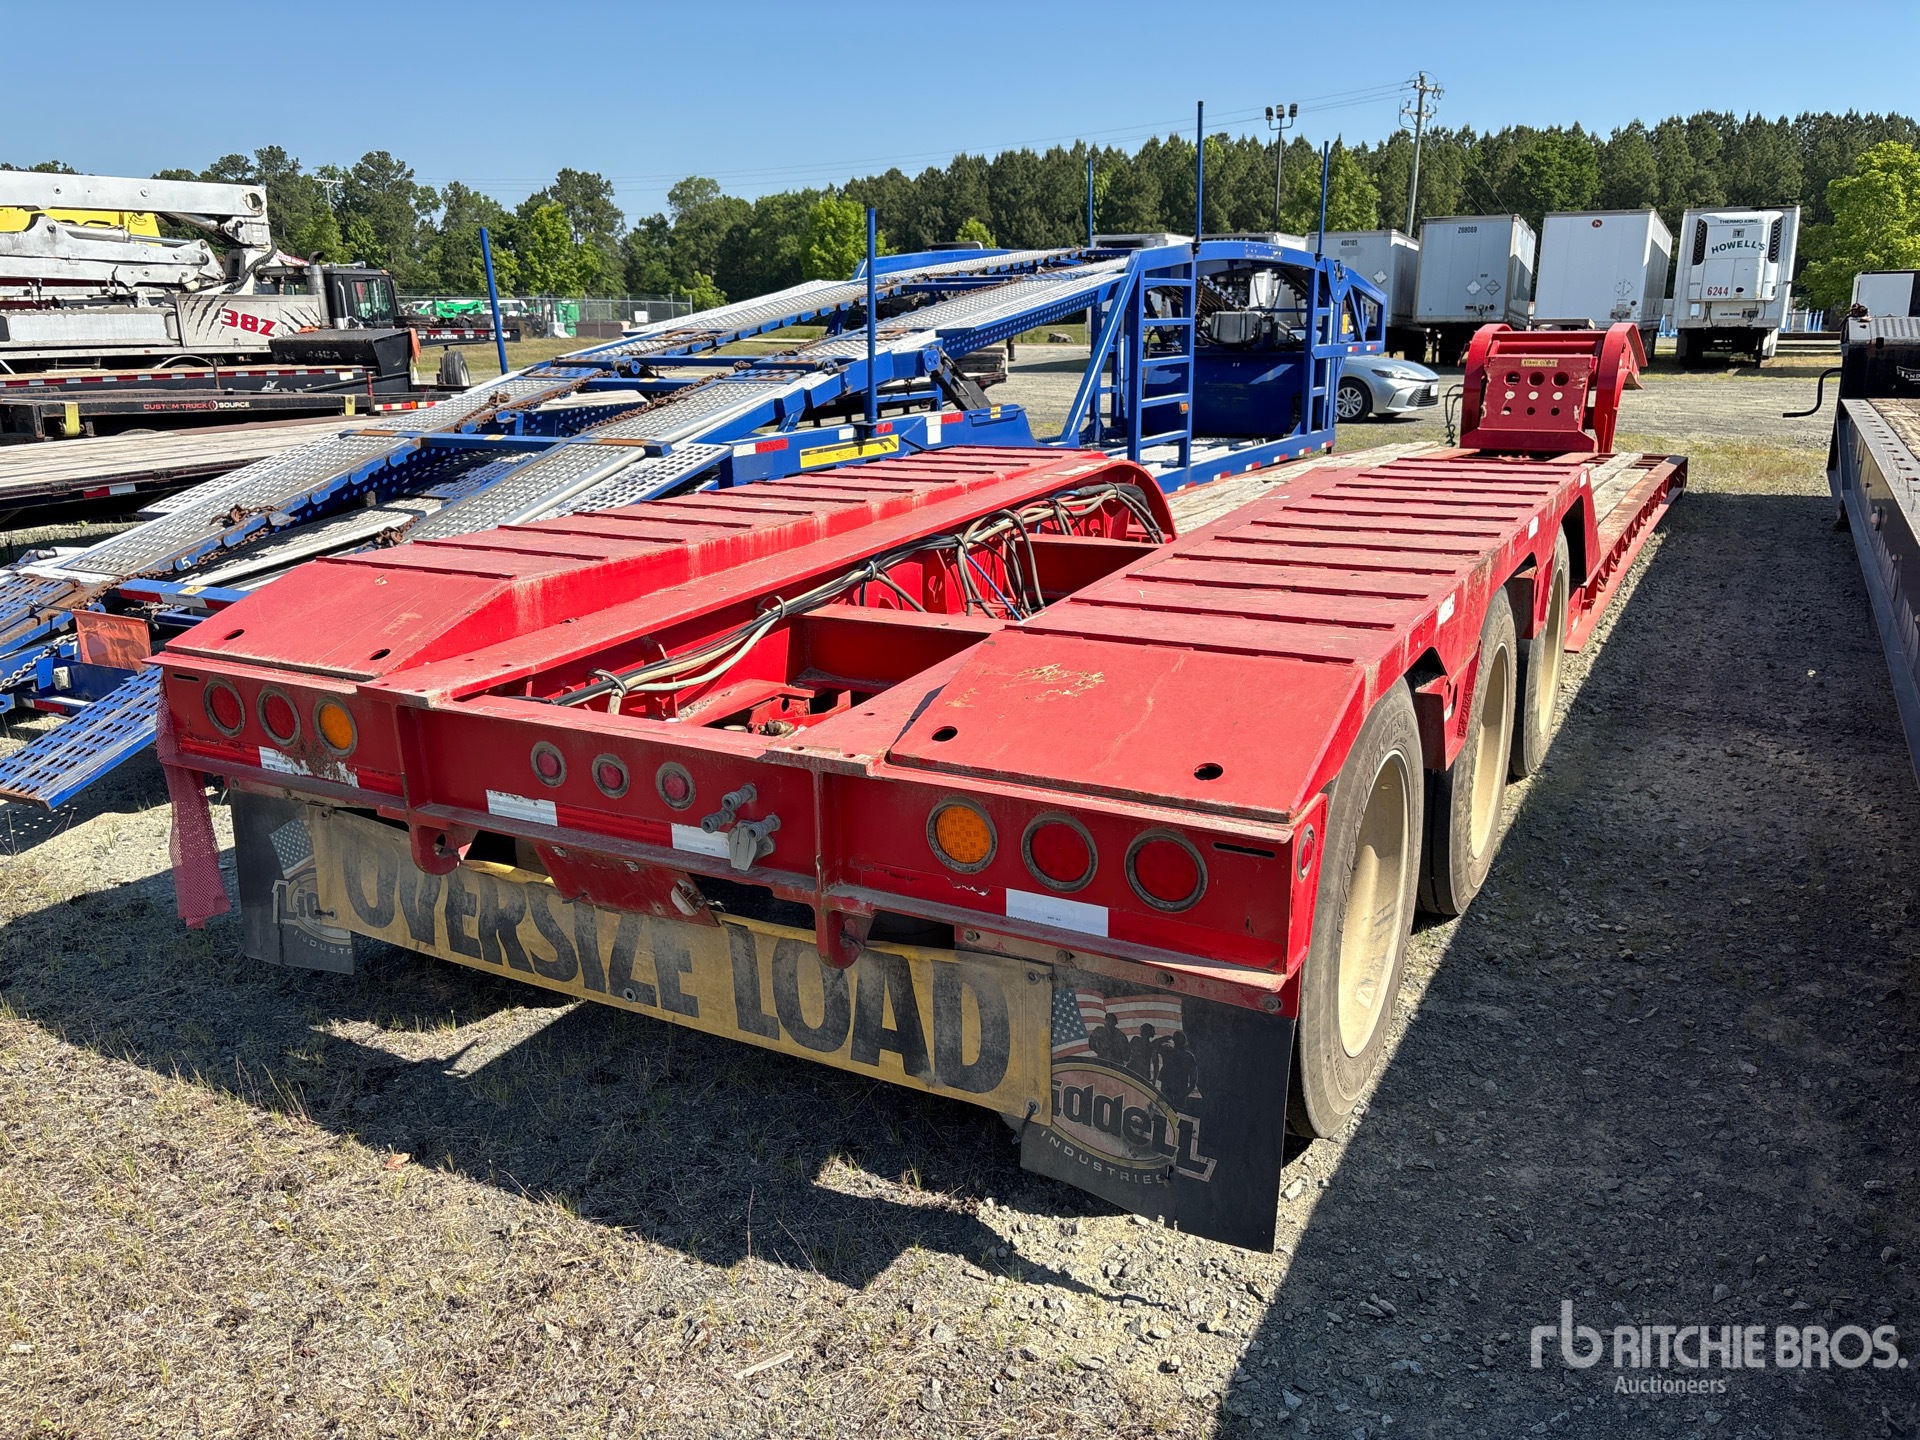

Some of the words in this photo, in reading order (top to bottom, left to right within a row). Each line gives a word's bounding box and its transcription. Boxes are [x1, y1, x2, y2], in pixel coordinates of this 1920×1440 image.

[1711, 240, 1766, 254] HOWELL'S
[1707, 286, 1729, 296] 6244
[220, 307, 277, 338] 38Z
[181, 556, 192, 569] 5
[344, 838, 699, 1018] OVERSIZE
[722, 920, 1010, 1094] LOAD
